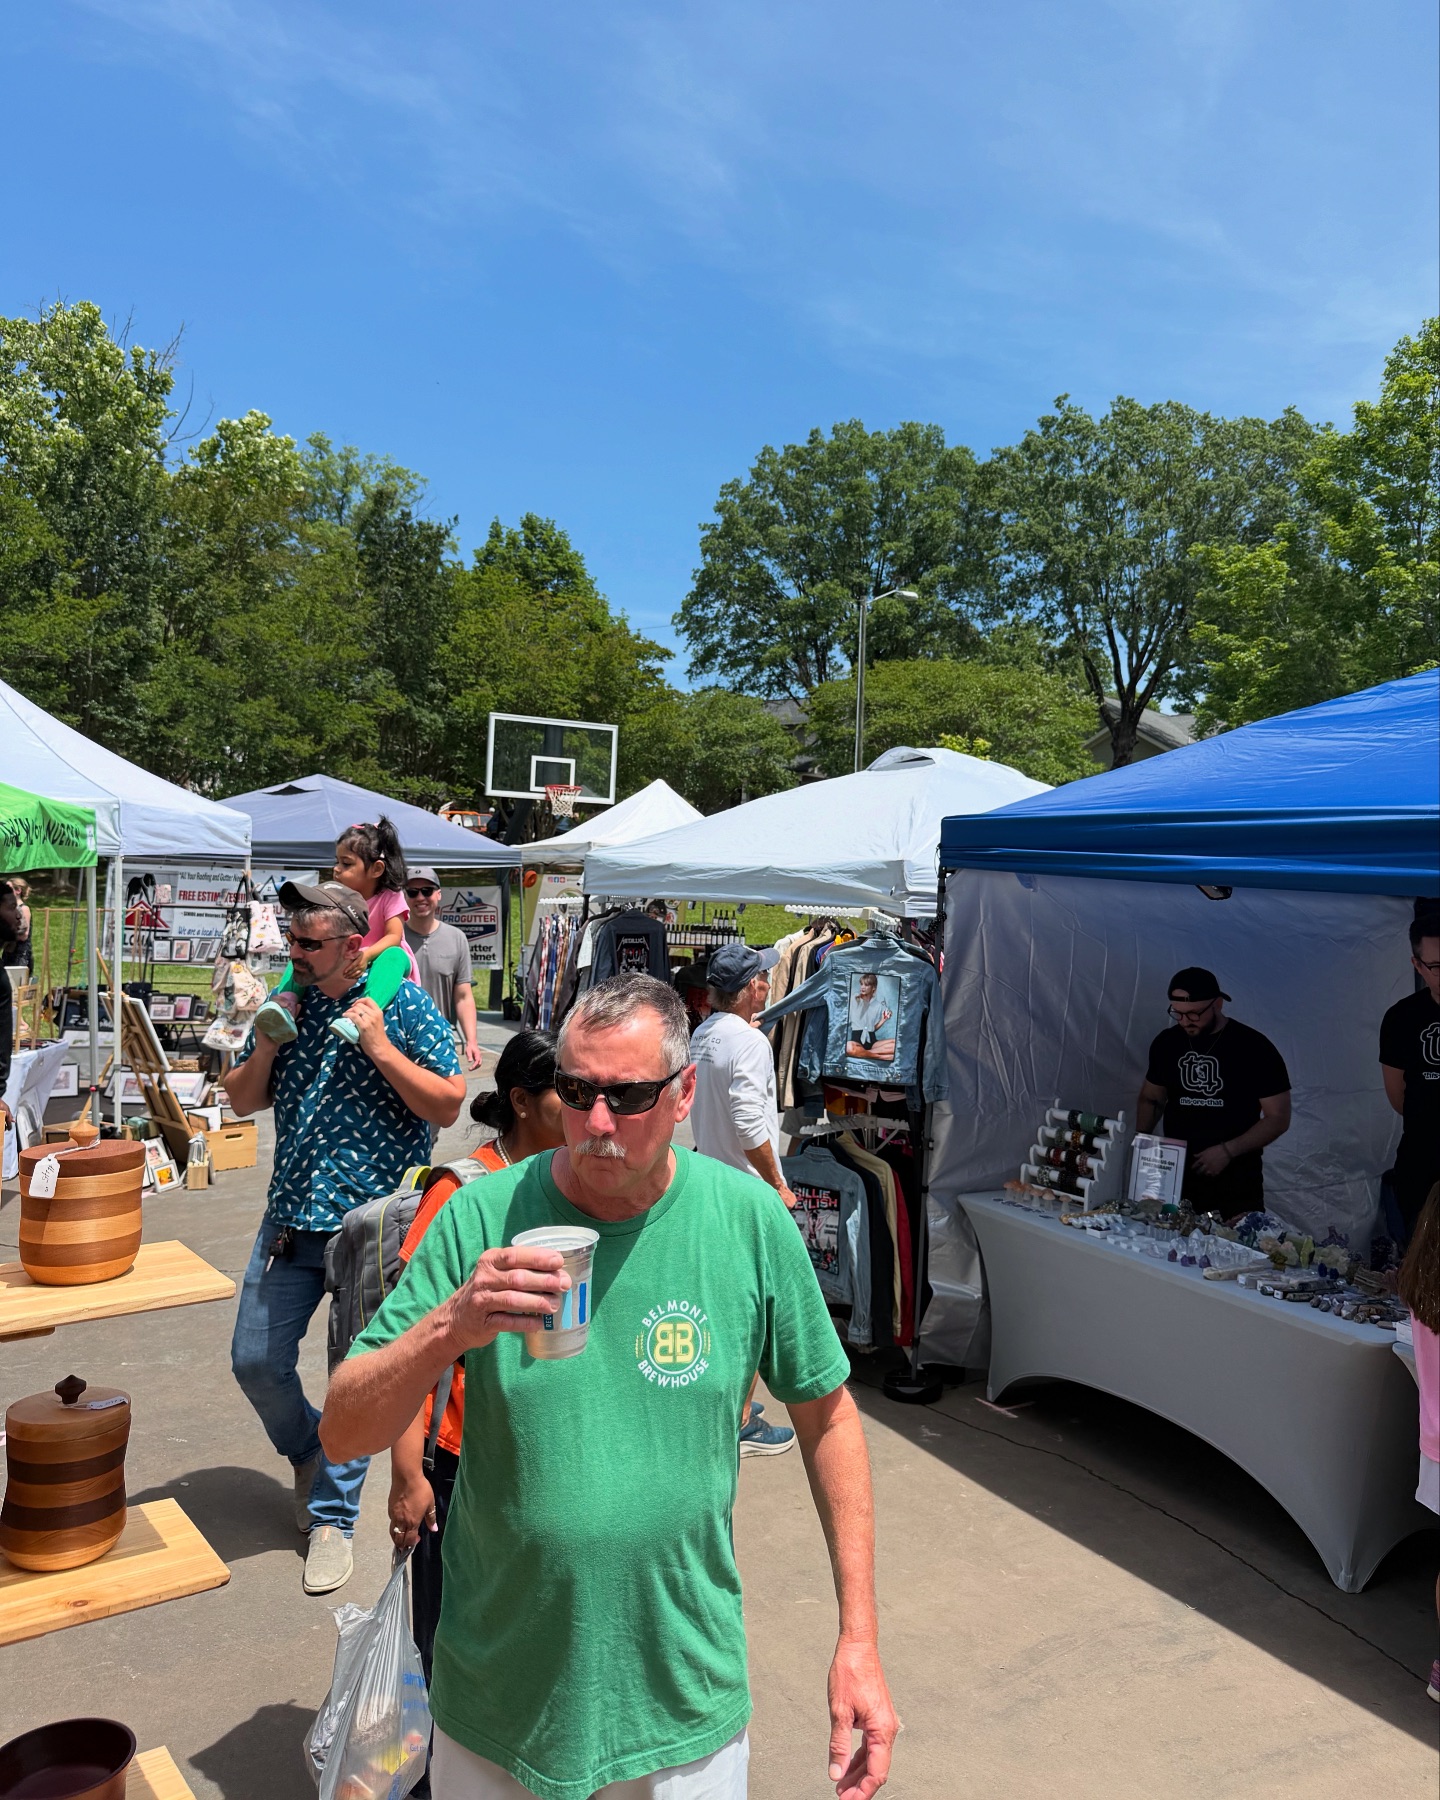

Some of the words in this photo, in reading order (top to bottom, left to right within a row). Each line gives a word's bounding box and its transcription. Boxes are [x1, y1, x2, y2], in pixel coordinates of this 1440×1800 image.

[187, 872, 196, 880] Your
[197, 872, 212, 882] Roofing
[212, 873, 220, 881] and
[220, 874, 233, 882] Gutter
[178, 889, 197, 901] FREE
[442, 914, 496, 923] PROGUTTER
[178, 926, 187, 935] We
[186, 928, 196, 936] are
[201, 927, 214, 936] local
[470, 943, 493, 953] utter
[470, 953, 497, 961] elmet
[641, 1299, 708, 1328] BELMONT
[637, 1357, 709, 1388] BREWHOUSE
